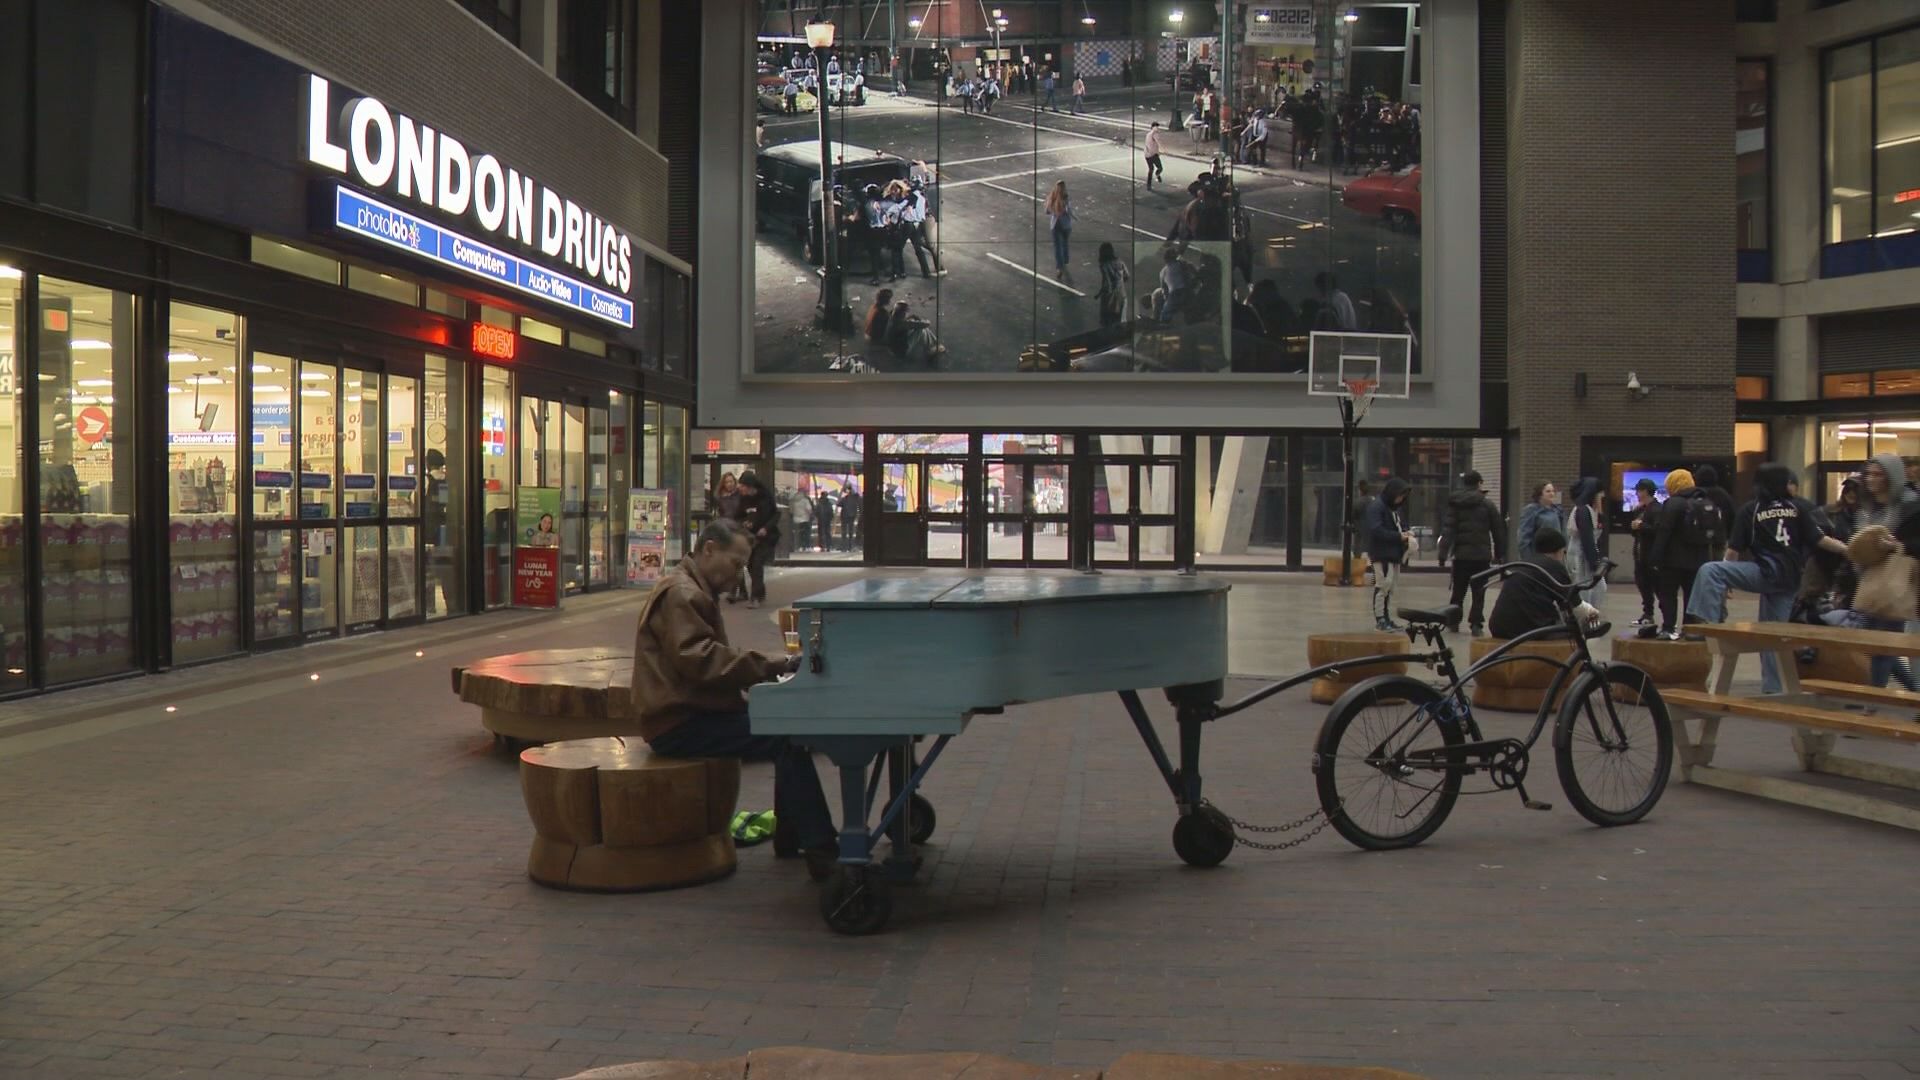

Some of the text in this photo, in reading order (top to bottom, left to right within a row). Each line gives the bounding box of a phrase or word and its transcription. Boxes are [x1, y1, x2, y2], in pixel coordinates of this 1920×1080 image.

[309, 74, 632, 294] LONDON DRUGS
[357, 206, 408, 242] photolab
[453, 239, 506, 276] Computers
[591, 294, 623, 319] Cosmetics
[478, 324, 514, 359] OPEN
[261, 405, 278, 414] order
[172, 434, 212, 444] Customer
[1775, 518, 1790, 546] 4
